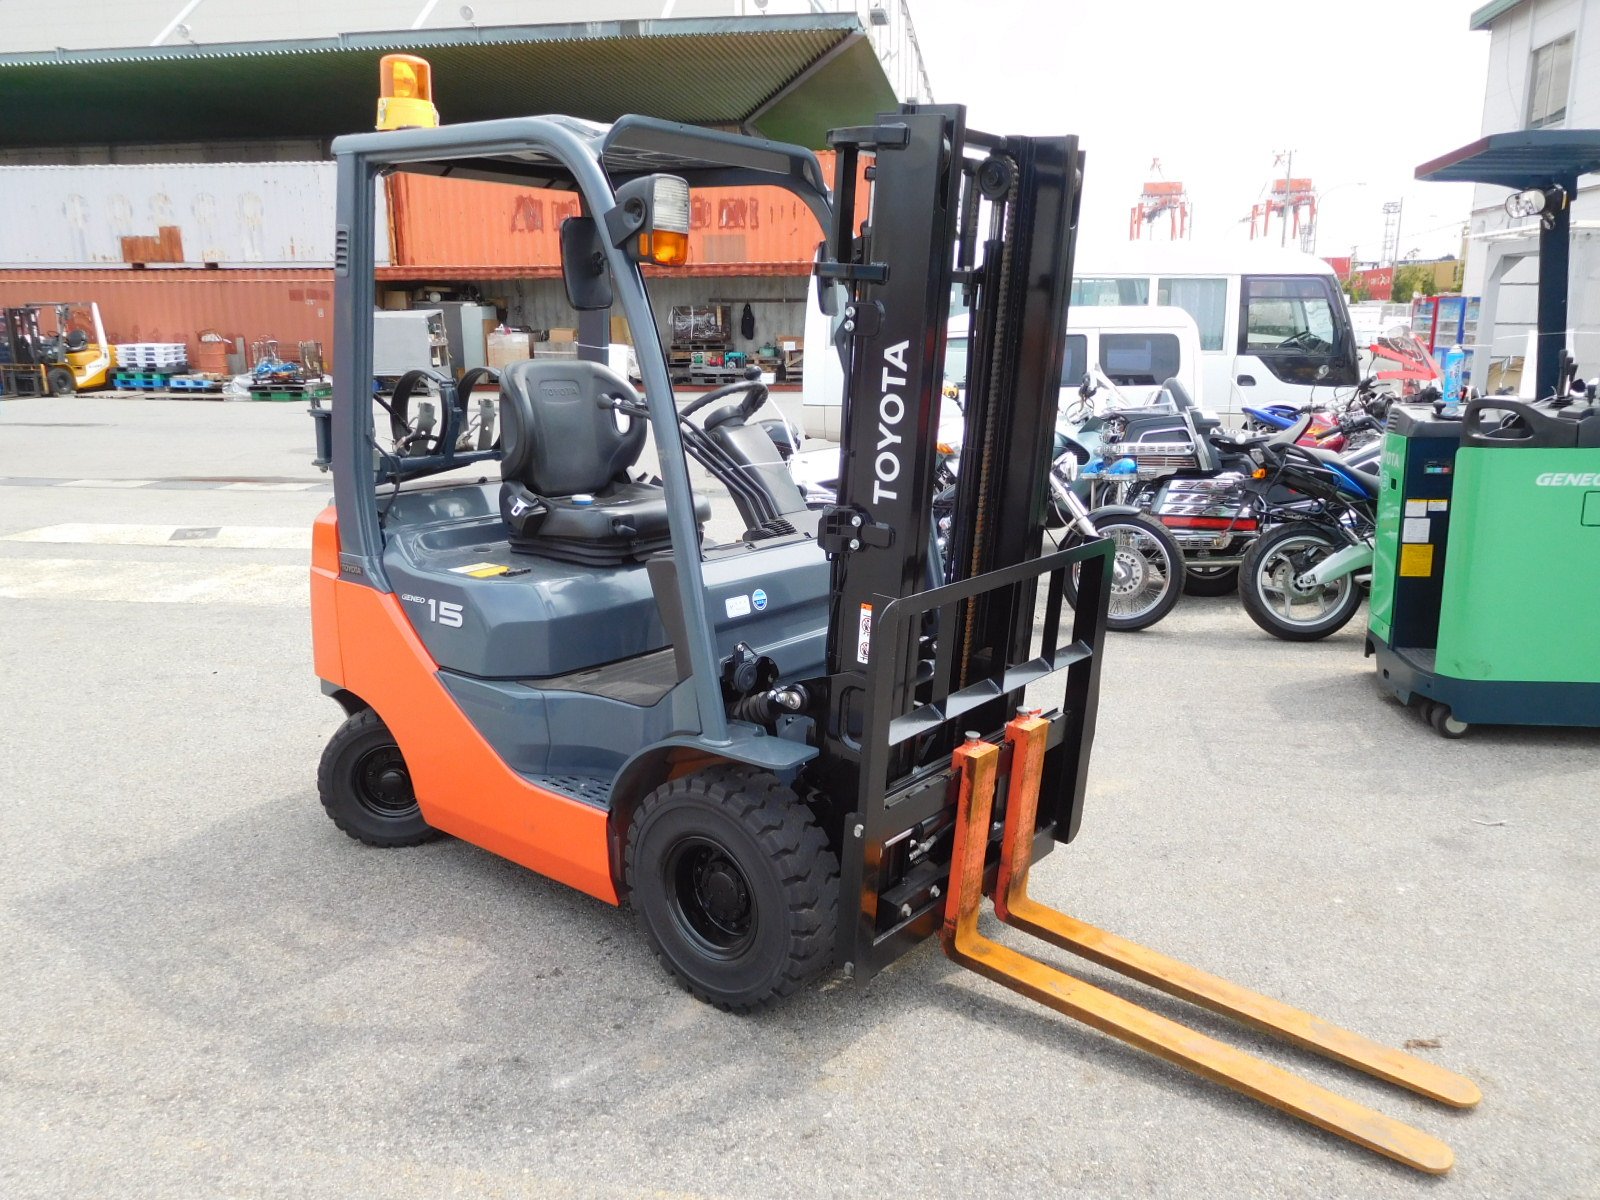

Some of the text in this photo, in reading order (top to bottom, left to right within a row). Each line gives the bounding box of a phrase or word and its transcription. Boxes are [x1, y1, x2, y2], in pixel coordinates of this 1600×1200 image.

[873, 340, 910, 504] TOYOTA
[401, 593, 425, 604] GENEO
[428, 598, 463, 628] 15
